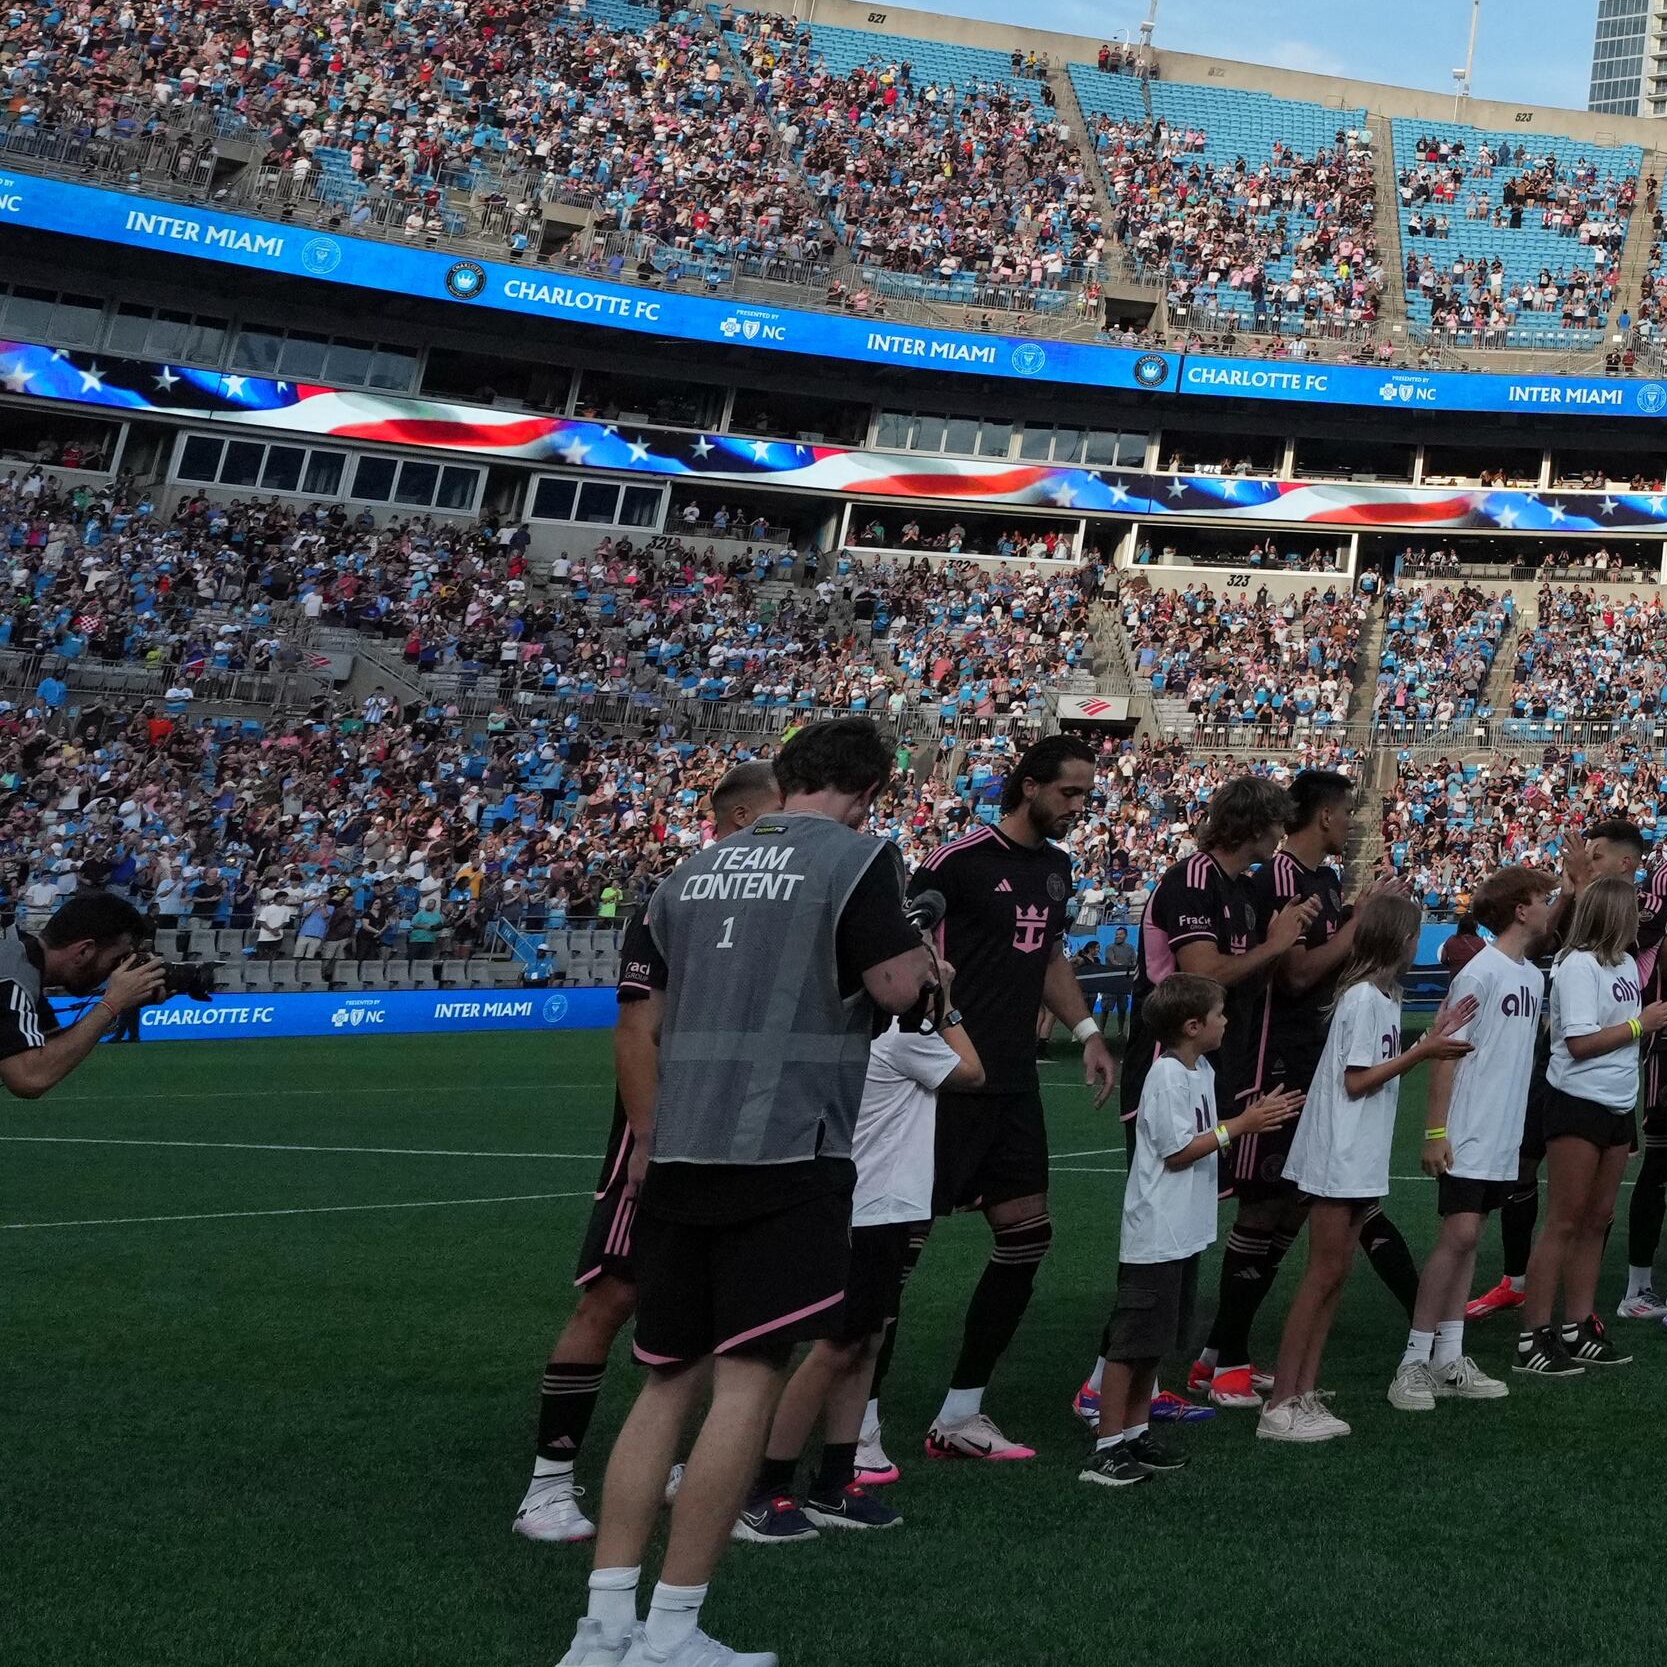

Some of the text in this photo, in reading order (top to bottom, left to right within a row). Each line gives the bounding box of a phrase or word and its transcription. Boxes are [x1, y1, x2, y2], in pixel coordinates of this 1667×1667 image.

[1515, 113, 1533, 122] 523
[126, 211, 285, 257] INTER MIAMI
[504, 279, 661, 321] CHARLOTTE FC
[762, 325, 786, 341] NC
[867, 333, 996, 364] INTER MIAMI
[1188, 367, 1328, 392] CHARLOTTE FC
[1416, 388, 1437, 401] NC
[1508, 386, 1623, 405] INTER MIAMI
[1227, 575, 1251, 587] 323
[712, 845, 795, 871] TEAM
[680, 873, 804, 902] CONTENT
[716, 916, 735, 949] 1
[1612, 976, 1641, 1007] ally
[141, 1007, 274, 1026] CHARLOTTE FC
[366, 1009, 385, 1023] NC
[434, 1002, 532, 1019] INTER MIAMI
[1502, 986, 1538, 1027] ally
